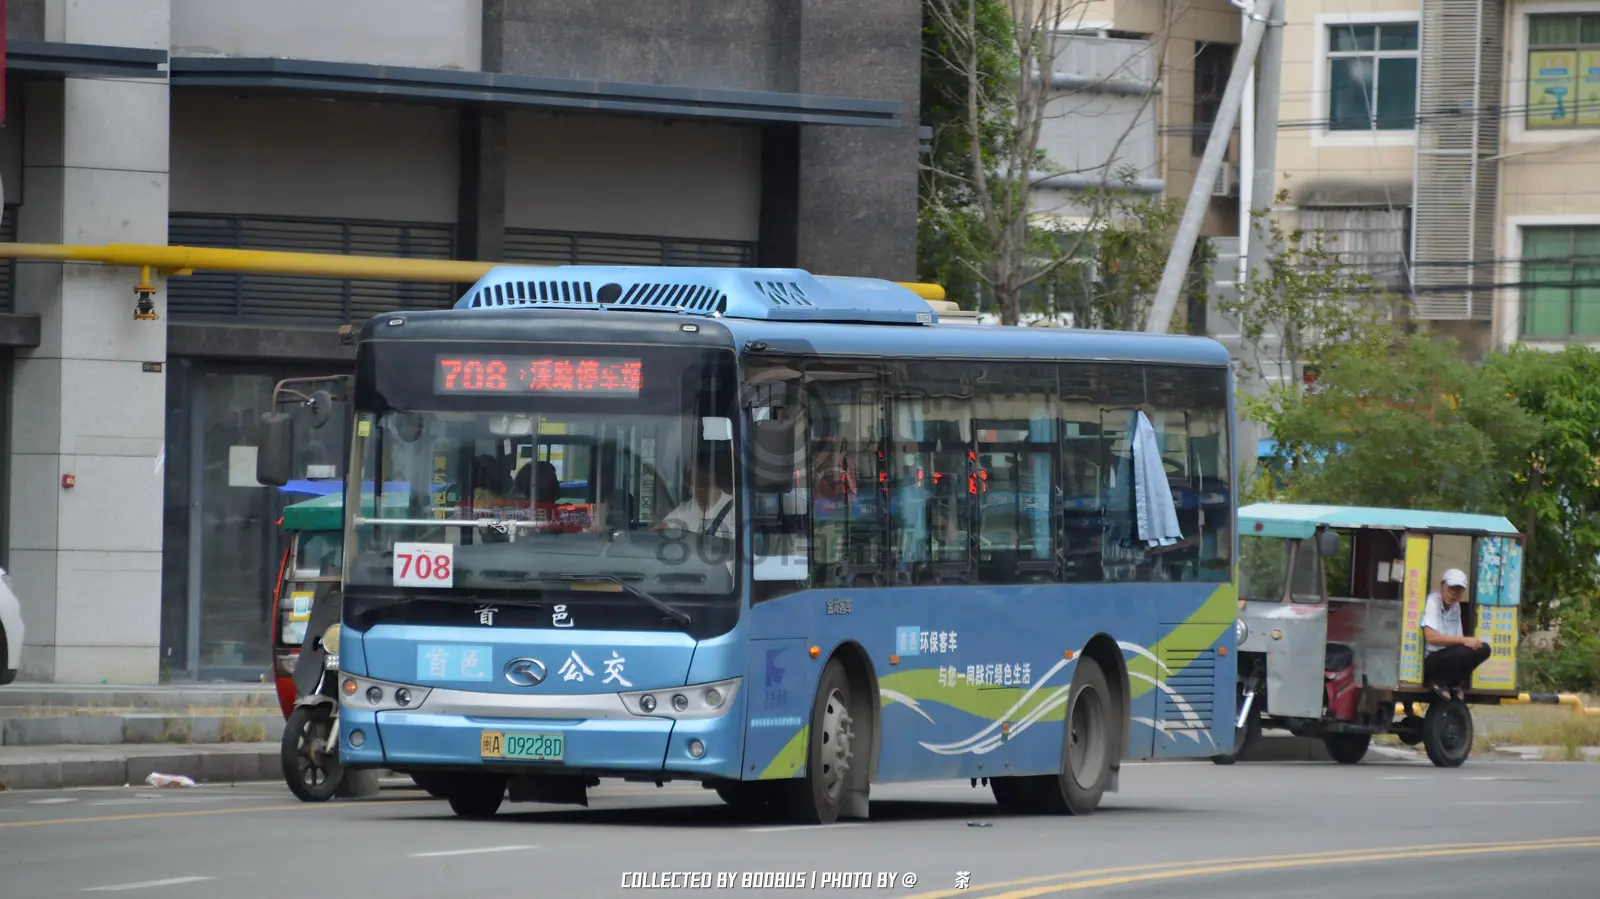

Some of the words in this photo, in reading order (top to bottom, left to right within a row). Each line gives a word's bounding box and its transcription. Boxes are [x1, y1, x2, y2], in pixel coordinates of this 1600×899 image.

[440, 359, 508, 390] 708
[397, 553, 451, 580] 708
[558, 650, 633, 688] 公交
[938, 663, 1031, 687] 与您一同践行绿色生活
